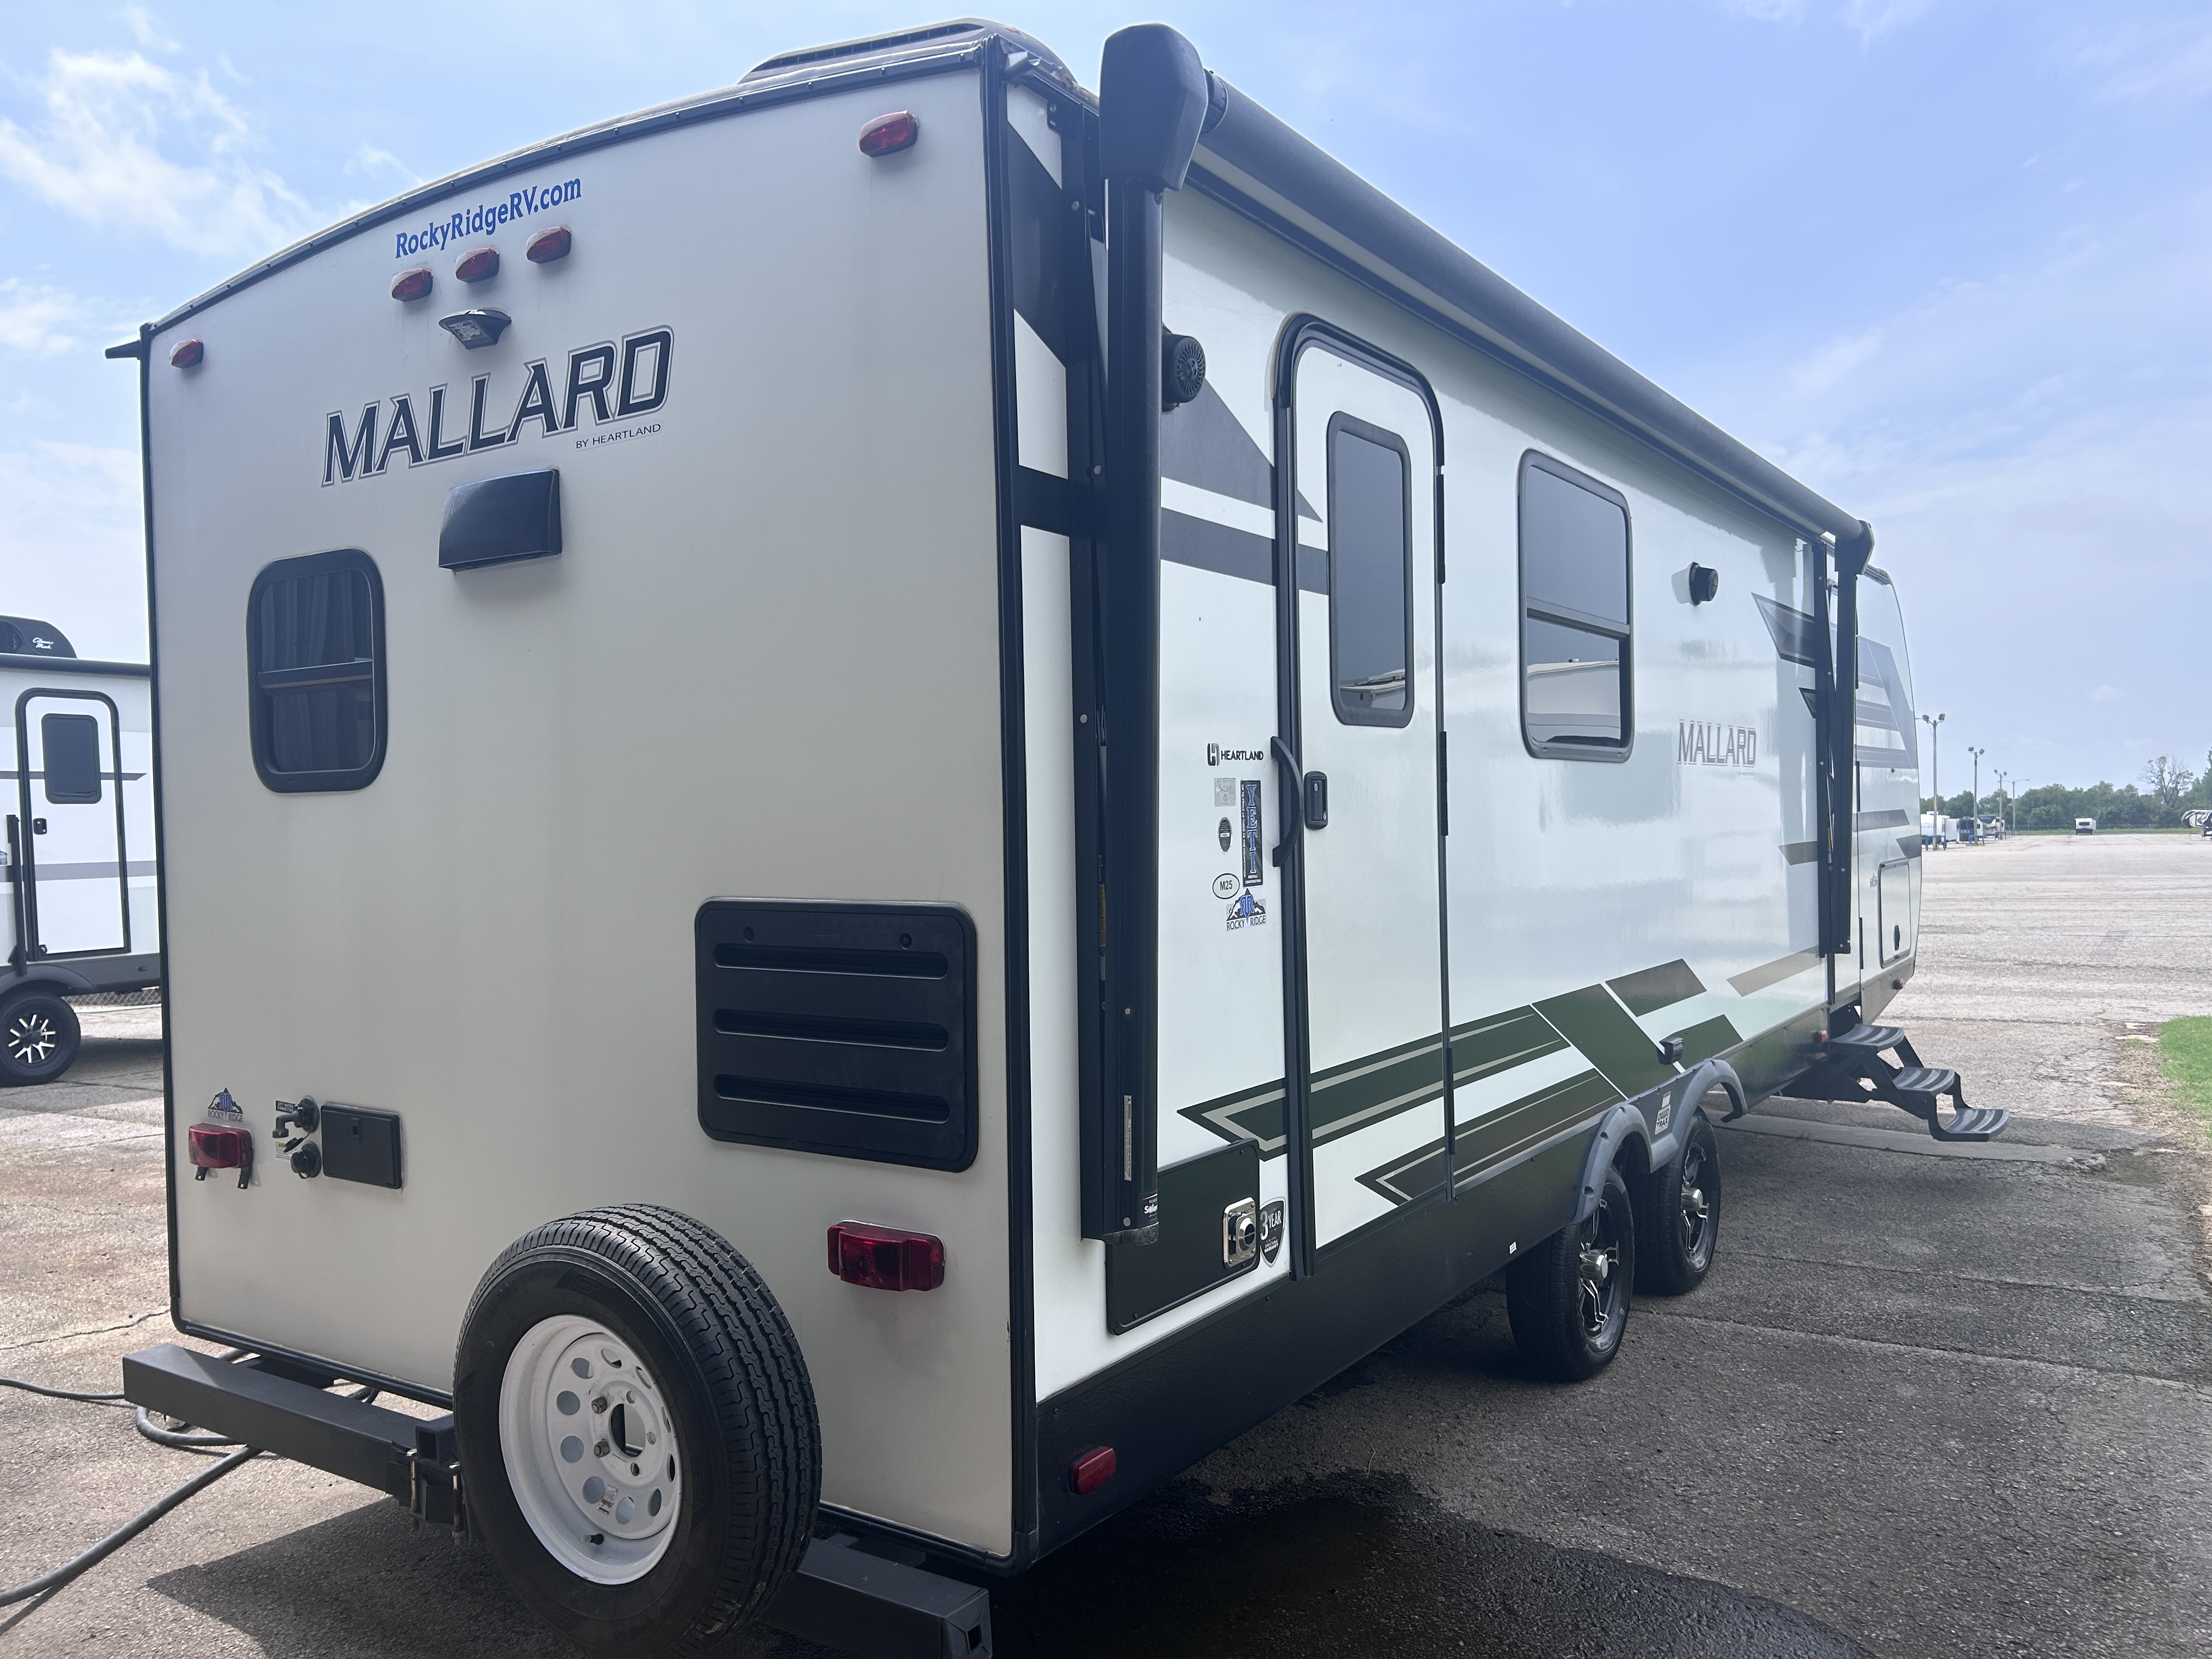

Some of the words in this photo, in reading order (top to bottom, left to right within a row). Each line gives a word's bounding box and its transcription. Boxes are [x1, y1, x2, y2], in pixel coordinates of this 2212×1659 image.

[395, 178, 582, 259] RockyRidgeRV.com
[321, 325, 674, 487] MALLARD
[576, 439, 589, 449] BY
[592, 424, 661, 445] HEARTLAND
[1221, 749, 1264, 760] HEARTLAND
[1677, 719, 1756, 767] MALLARD
[1246, 784, 1257, 873] YETI
[1220, 880, 1233, 890] M25
[1226, 918, 1245, 931] ROCKY
[1250, 915, 1266, 927] RIDGE
[208, 1110, 224, 1120] ROCKY
[228, 1113, 243, 1122] RIDGE
[1260, 1210, 1268, 1240] 3
[1268, 1210, 1282, 1229] YEAR
